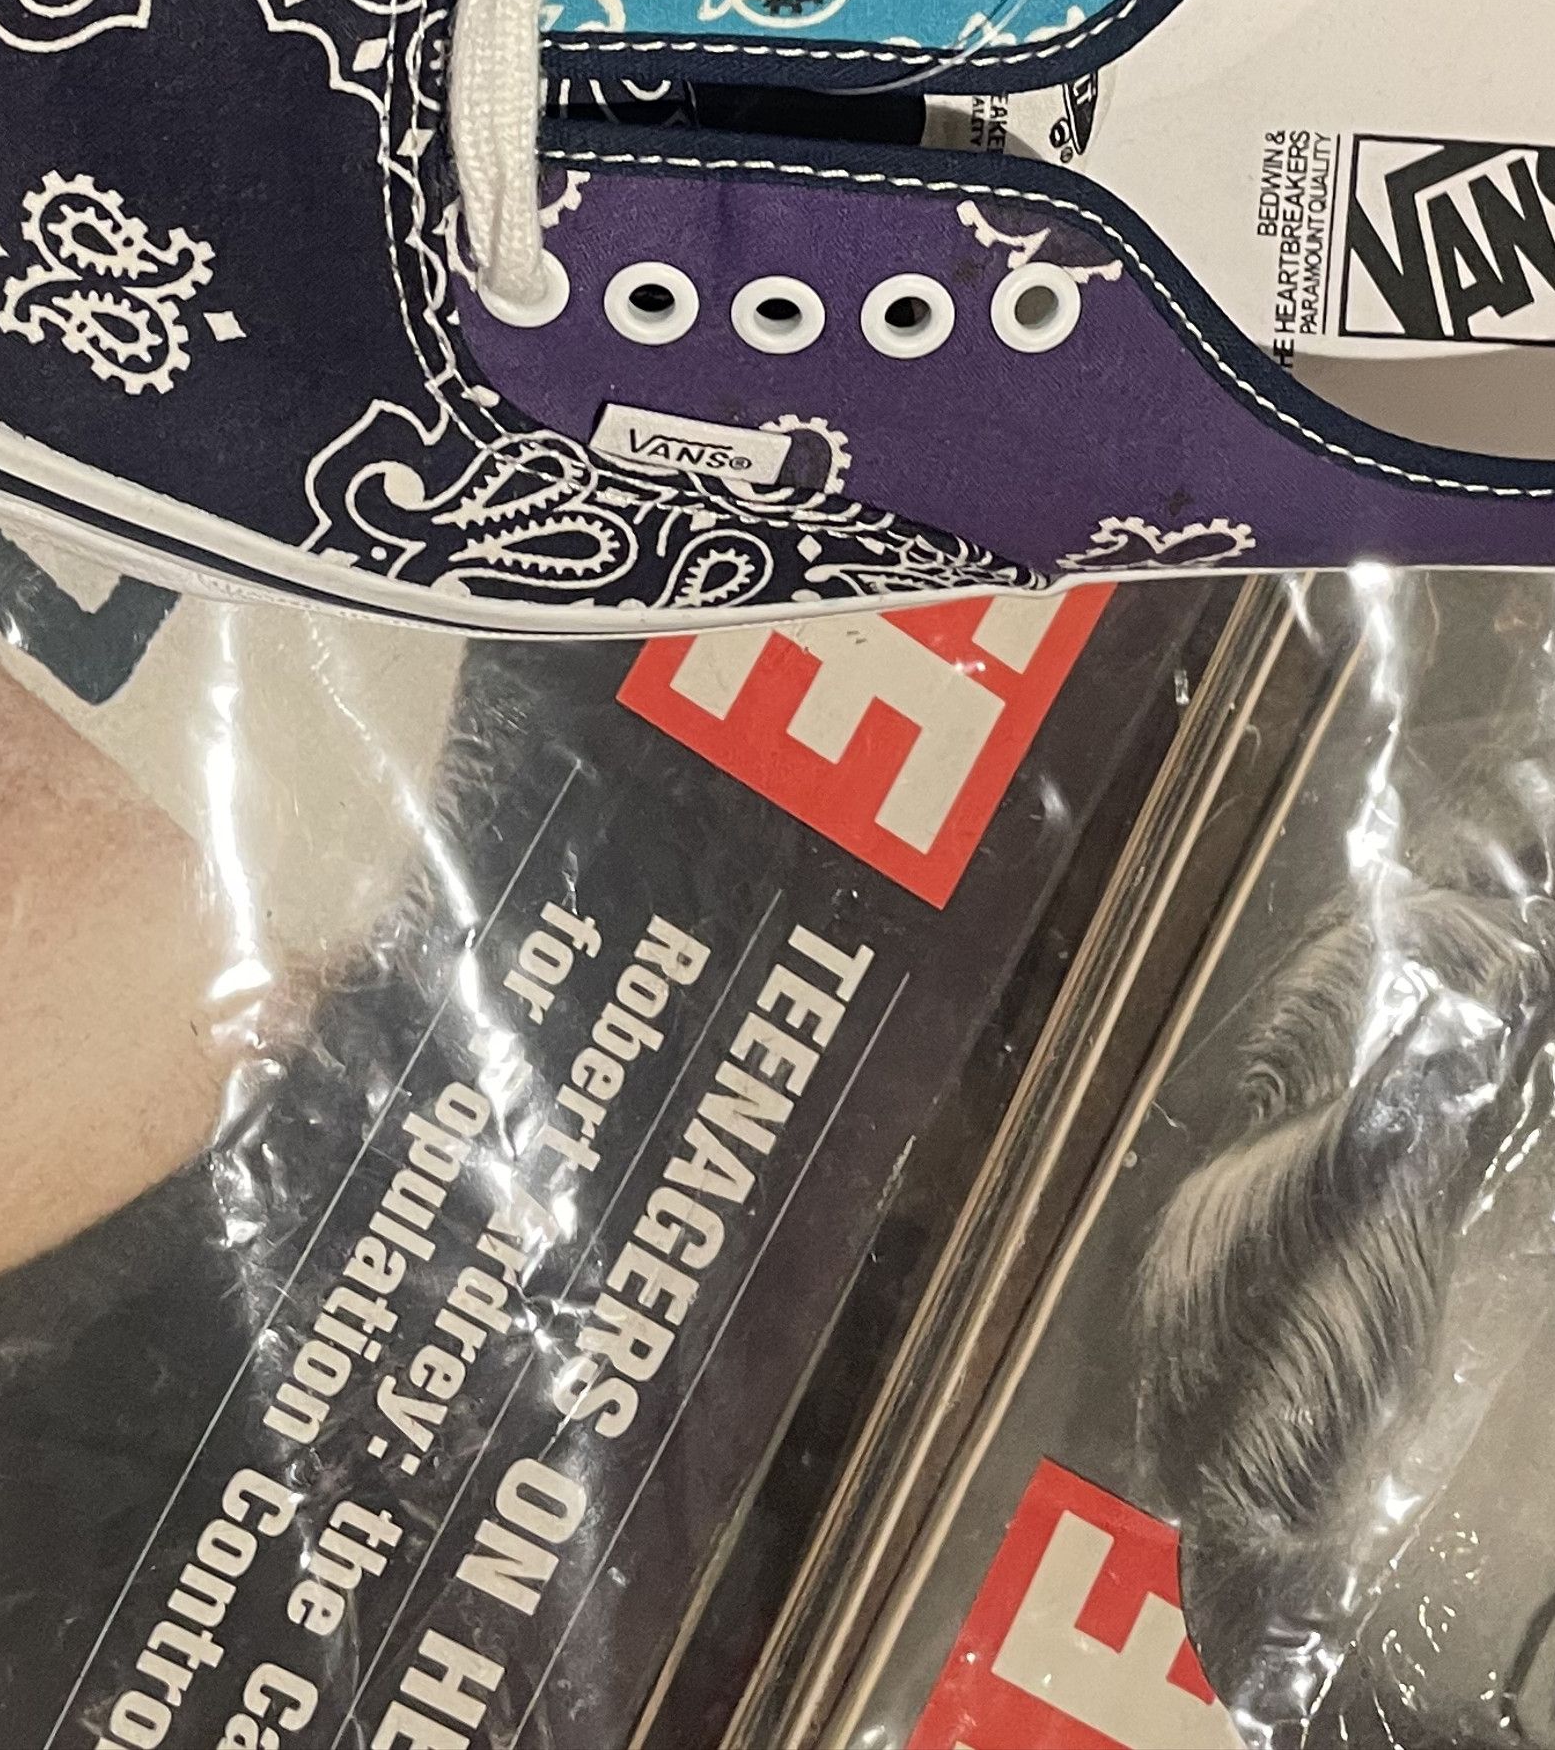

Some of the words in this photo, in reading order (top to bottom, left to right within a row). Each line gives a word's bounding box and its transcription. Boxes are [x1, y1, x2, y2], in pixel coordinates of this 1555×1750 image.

[1258, 149, 1284, 237] BEDWIN
[1274, 130, 1310, 334] HEARTBREAKERS
[1308, 131, 1331, 213] QUALITY
[1300, 215, 1324, 335] PARAMOUNT
[1273, 339, 1294, 368] HE
[503, 901, 603, 1025] for
[544, 914, 712, 1172] Robert
[263, 1050, 509, 1444] opulation
[552, 924, 875, 1439] TEENAGERS
[93, 1468, 301, 1750] Contro
[287, 1499, 404, 1636] the
[456, 1457, 587, 1617] ON
